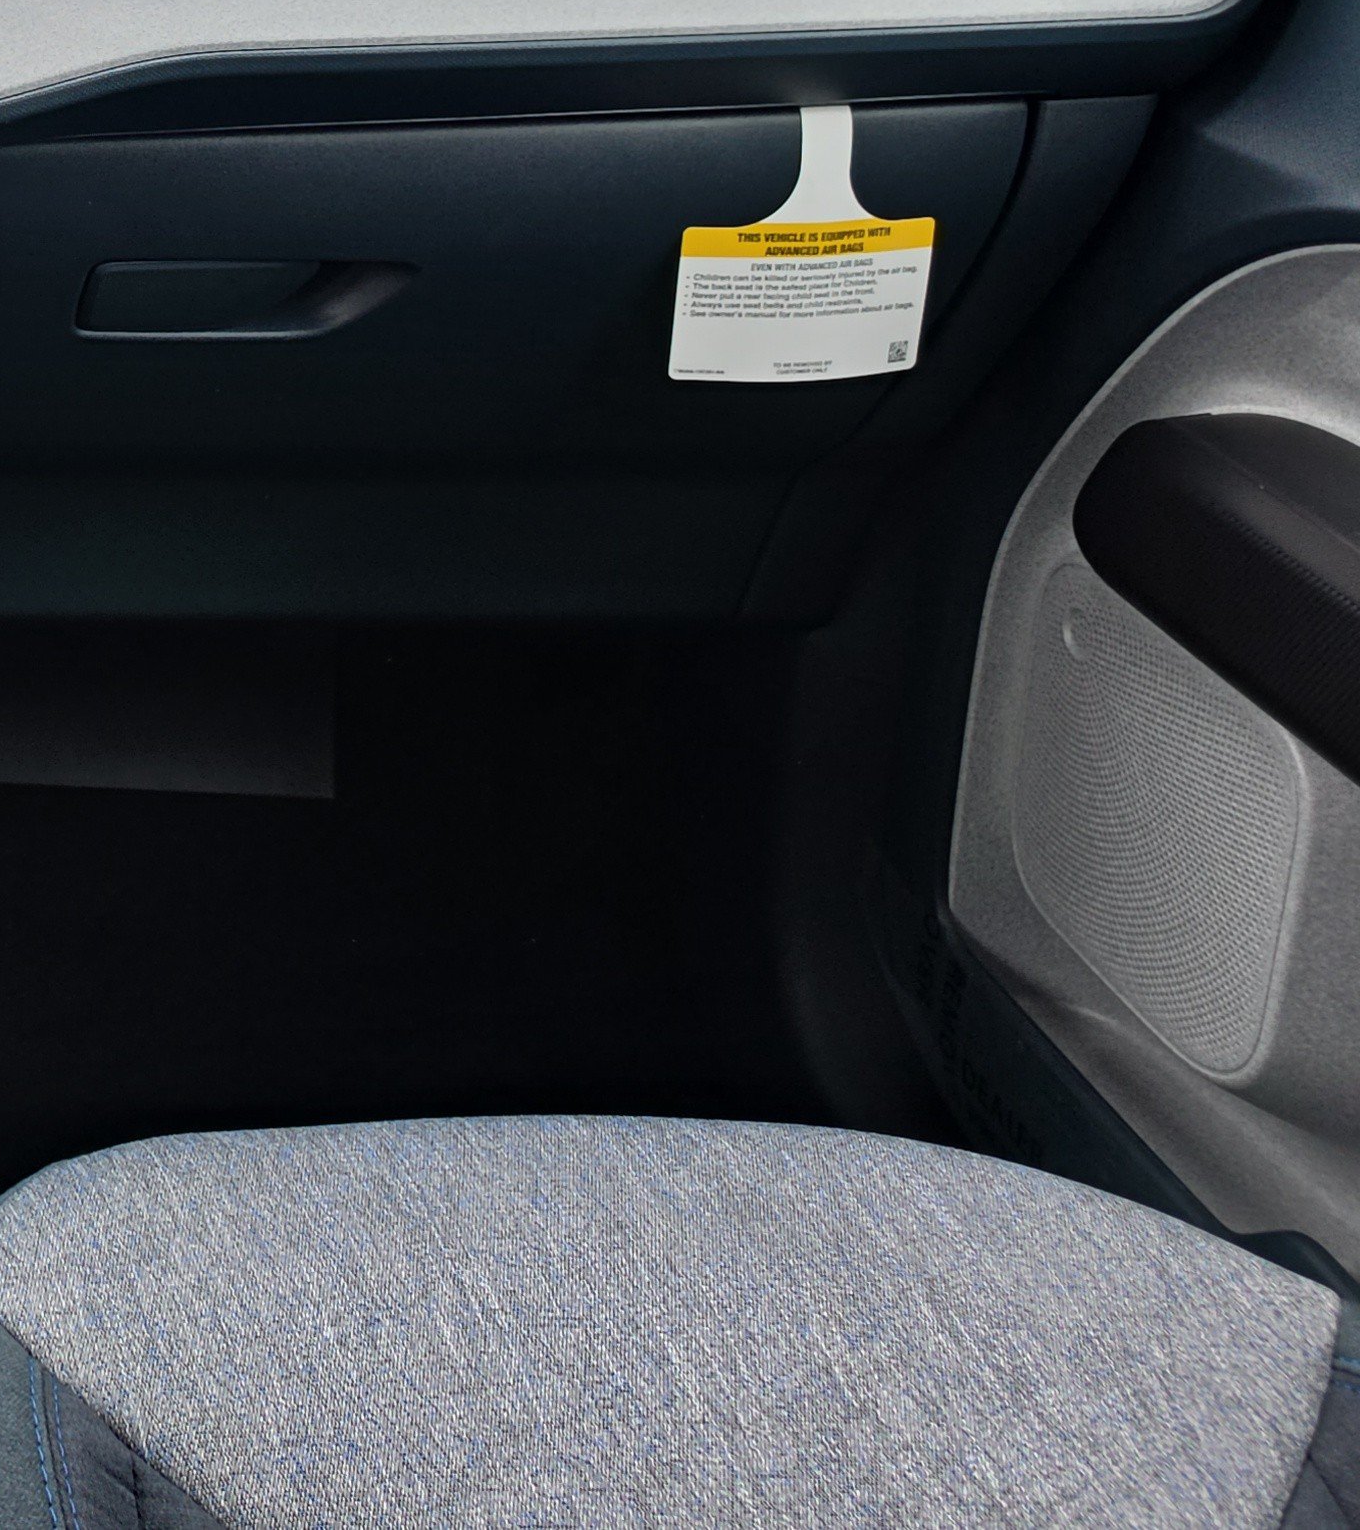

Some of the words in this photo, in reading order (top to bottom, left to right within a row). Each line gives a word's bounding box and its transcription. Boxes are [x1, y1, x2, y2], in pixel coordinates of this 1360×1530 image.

[737, 233, 761, 242] THIS
[764, 233, 806, 242] VEHICLE
[808, 232, 818, 241] IS
[821, 229, 865, 242] EQUIPPED
[868, 227, 891, 237] WITH
[765, 245, 818, 256] ADVANCED
[821, 244, 838, 255] AIR
[840, 242, 864, 253] BAGS
[798, 261, 837, 270] ADVANCED
